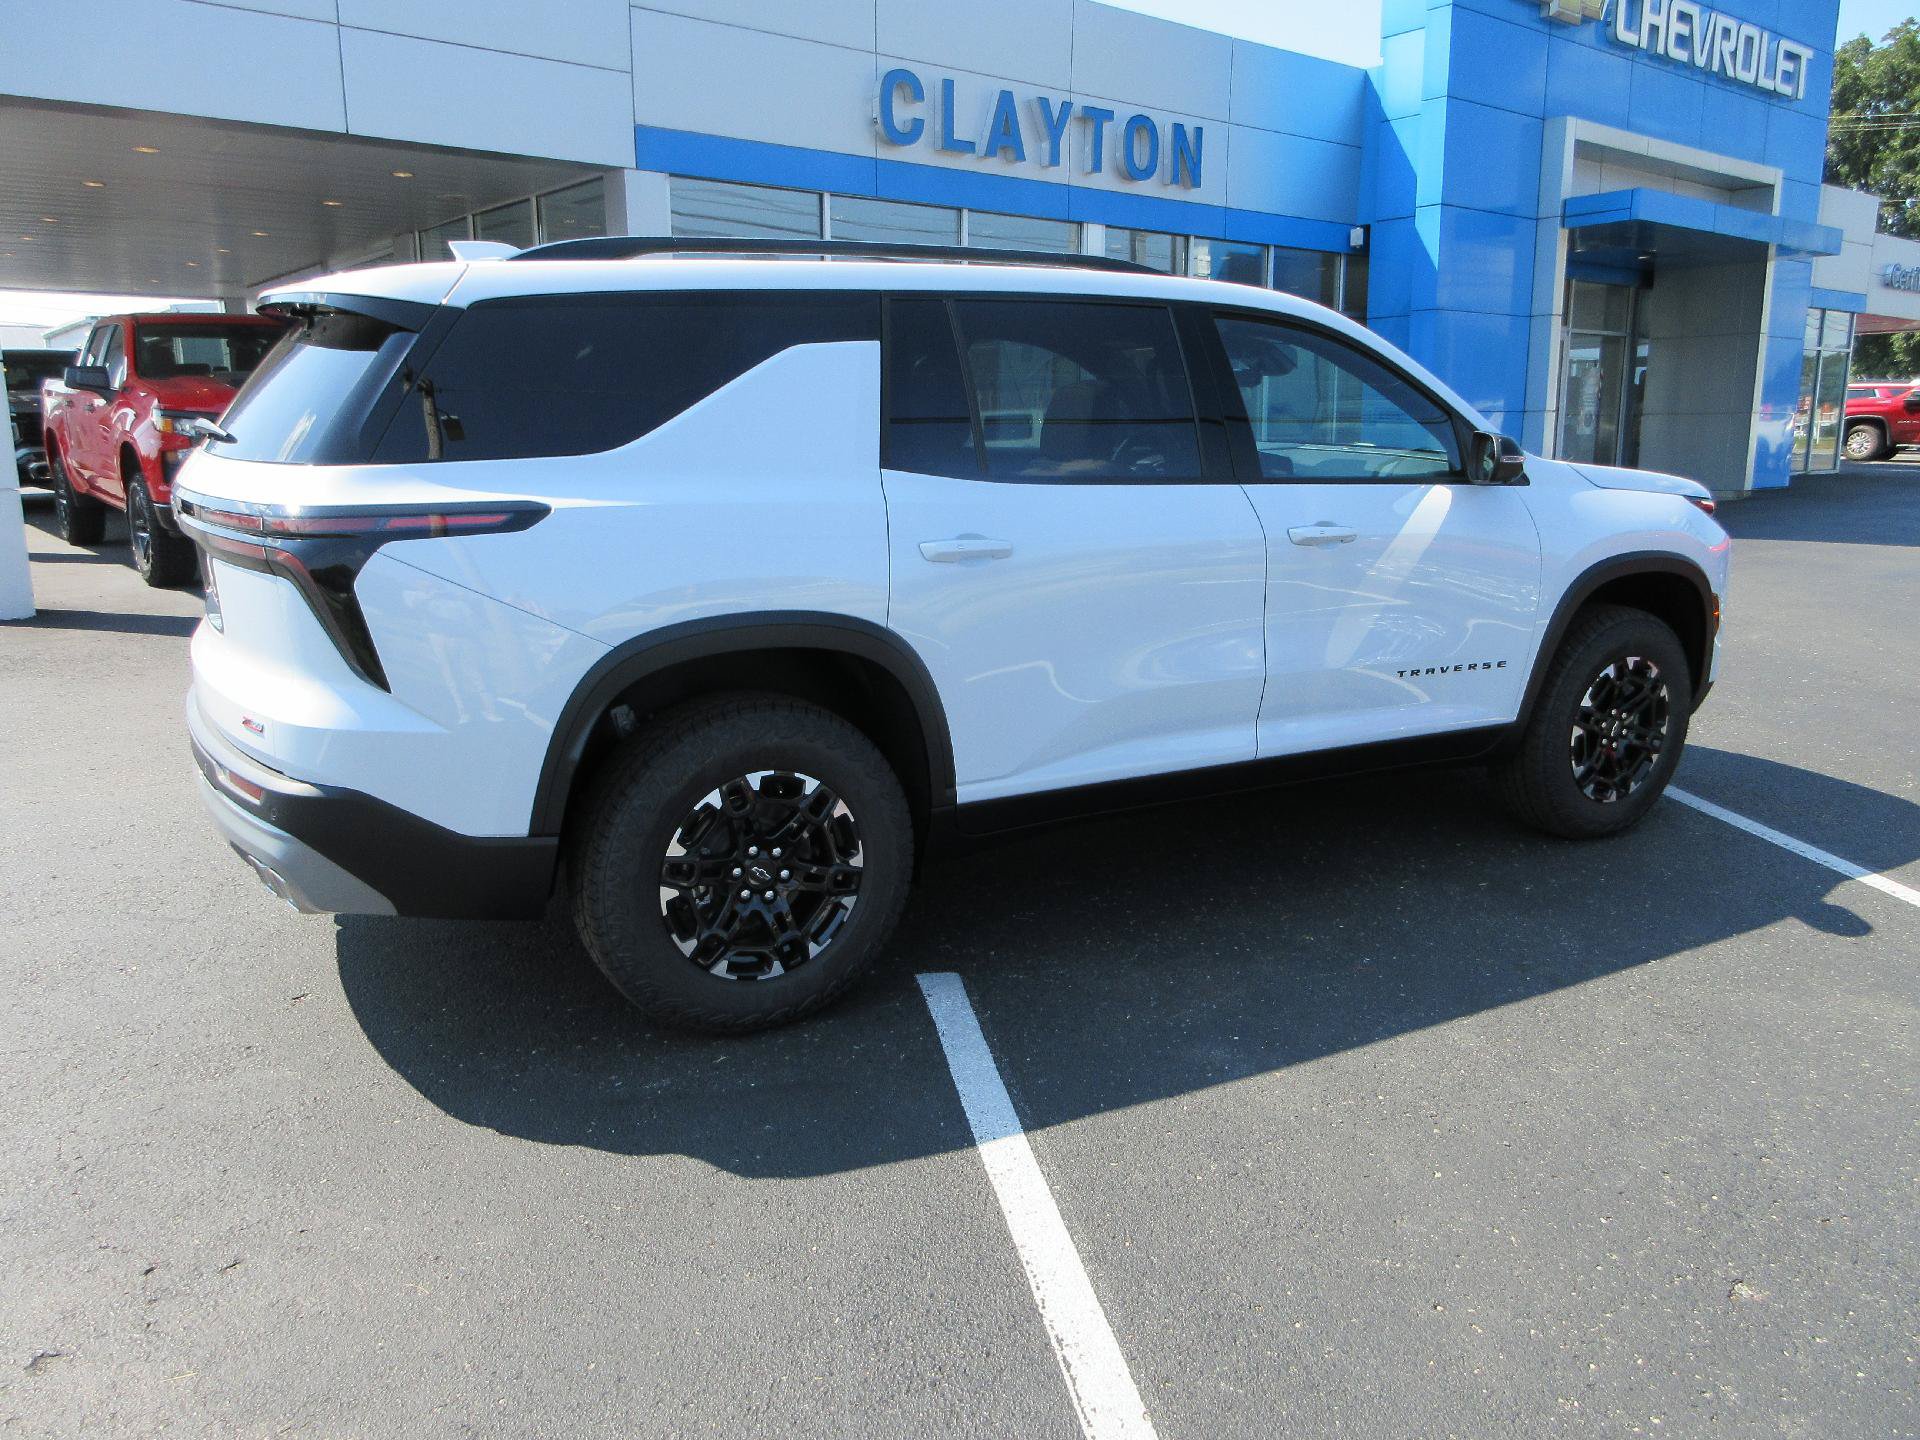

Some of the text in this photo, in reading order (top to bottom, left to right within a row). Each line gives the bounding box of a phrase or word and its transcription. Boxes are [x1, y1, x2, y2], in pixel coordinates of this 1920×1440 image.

[1615, 0, 1814, 99] CHEVROLET
[877, 67, 1204, 189] CLAYTON
[1397, 660, 1507, 678] TRAVERSE
